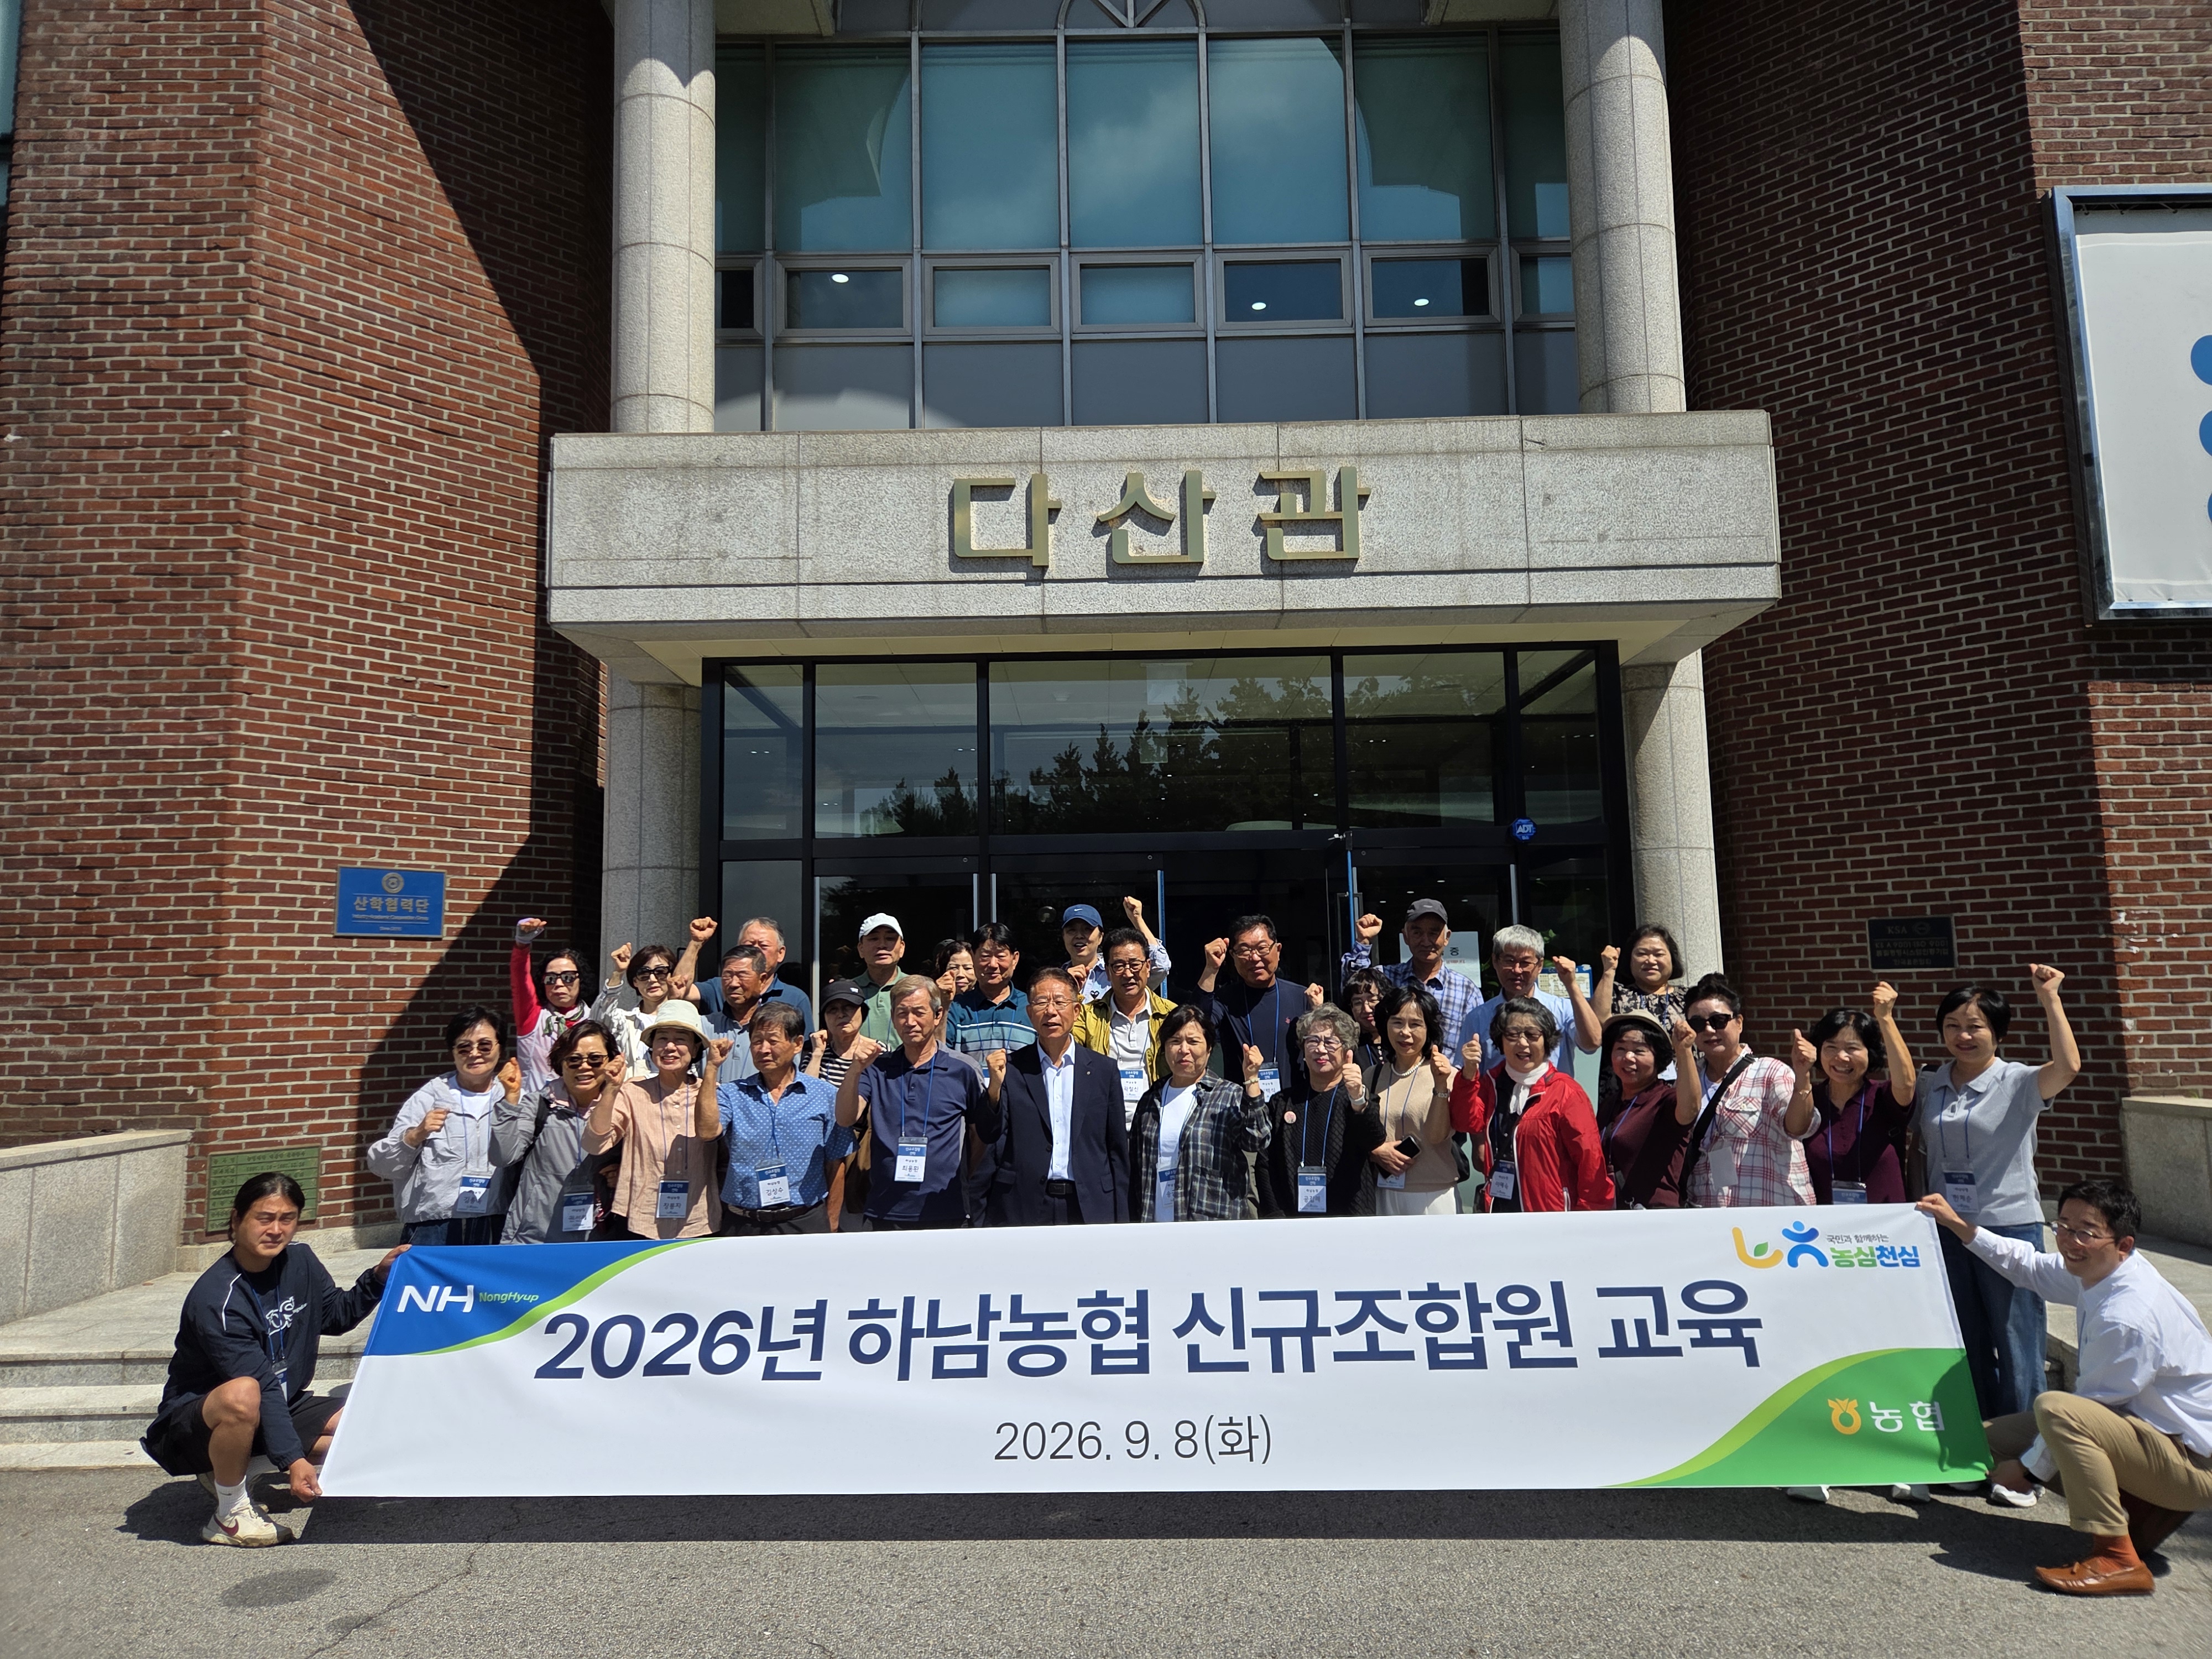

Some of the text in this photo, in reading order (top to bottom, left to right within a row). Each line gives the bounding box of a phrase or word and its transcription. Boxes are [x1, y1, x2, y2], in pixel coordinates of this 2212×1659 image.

[954, 466, 1371, 566] 다산관
[1516, 825, 1533, 833] ADT
[354, 896, 429, 912] 산학협력단
[1827, 1234, 1889, 1244] 국민과 함께하는
[1830, 1245, 1921, 1267] 농심천심
[397, 1285, 539, 1313] NH NongHyup
[534, 1280, 1763, 1381] 2026년 하남농협 신규조합원 교육
[1869, 1400, 1945, 1433] 농협
[995, 1414, 1271, 1465] 2026. 9. 8(화)
